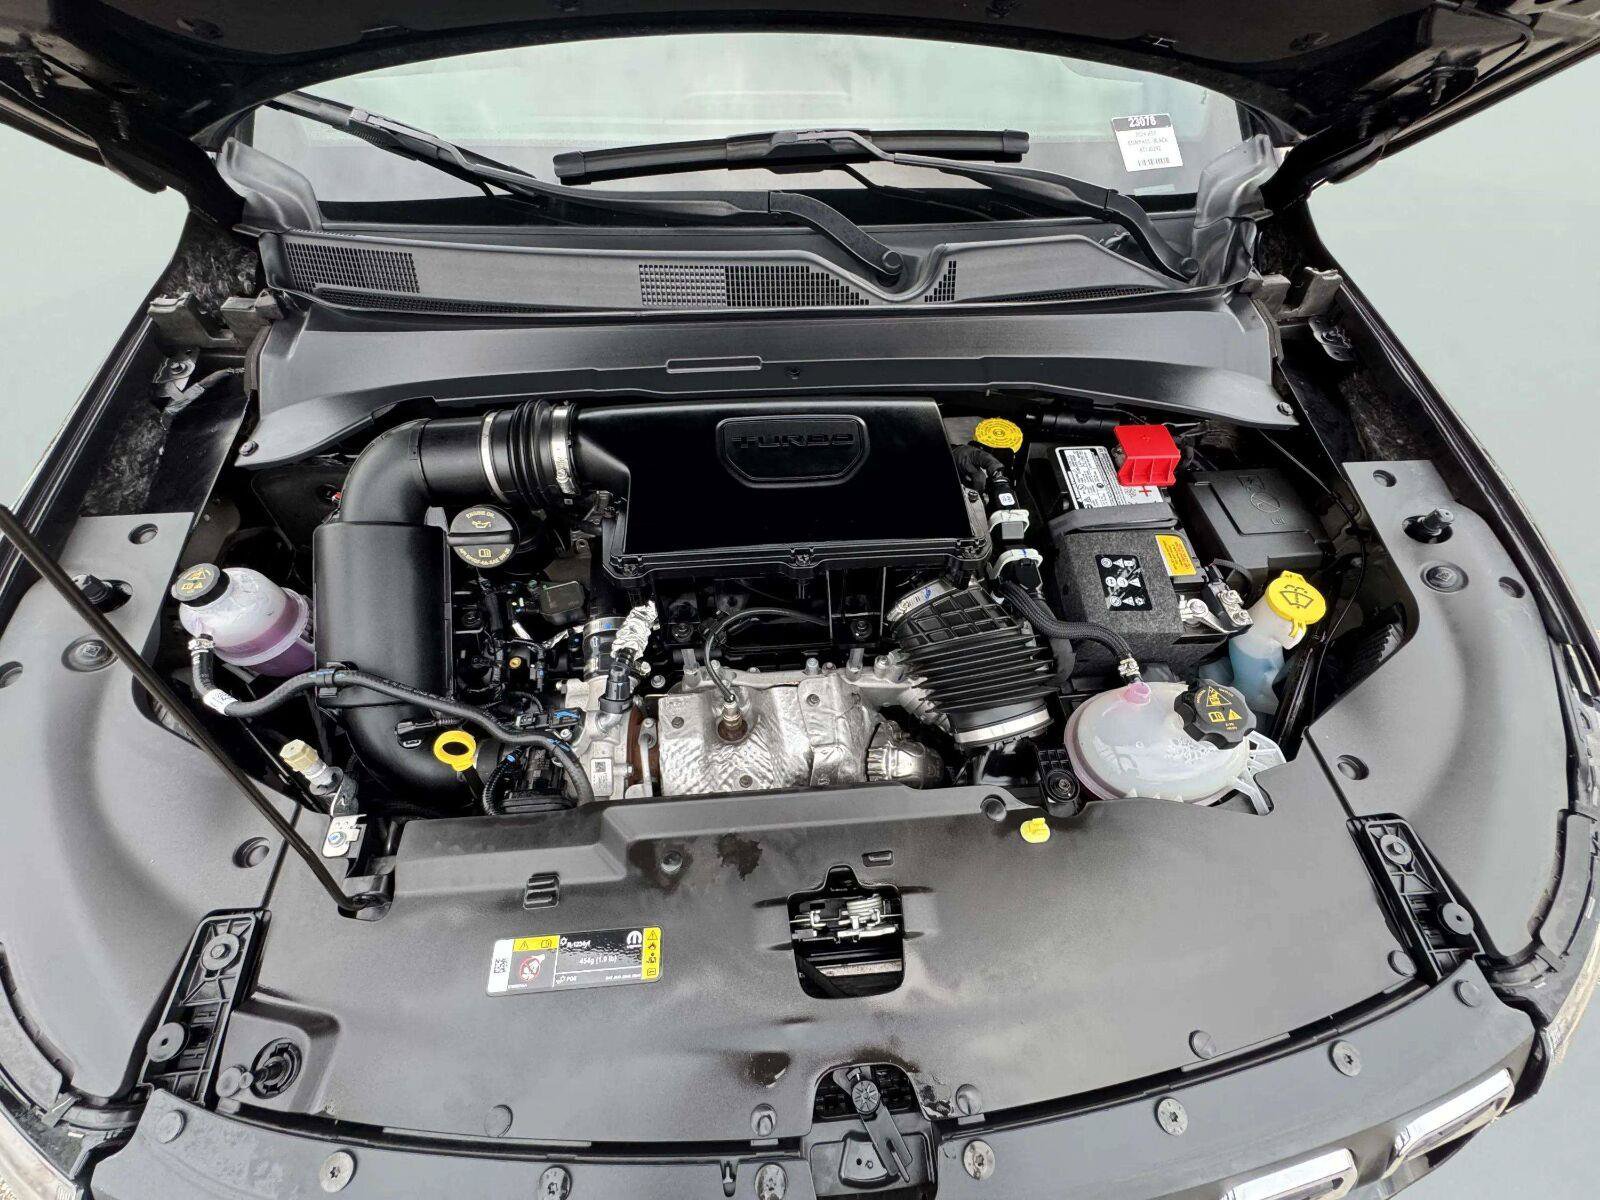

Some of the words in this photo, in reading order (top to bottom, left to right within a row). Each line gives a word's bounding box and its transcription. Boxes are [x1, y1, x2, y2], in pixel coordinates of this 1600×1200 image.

[731, 433, 855, 448] TURBO
[465, 510, 486, 519] ENGINE
[486, 511, 496, 519] OIL
